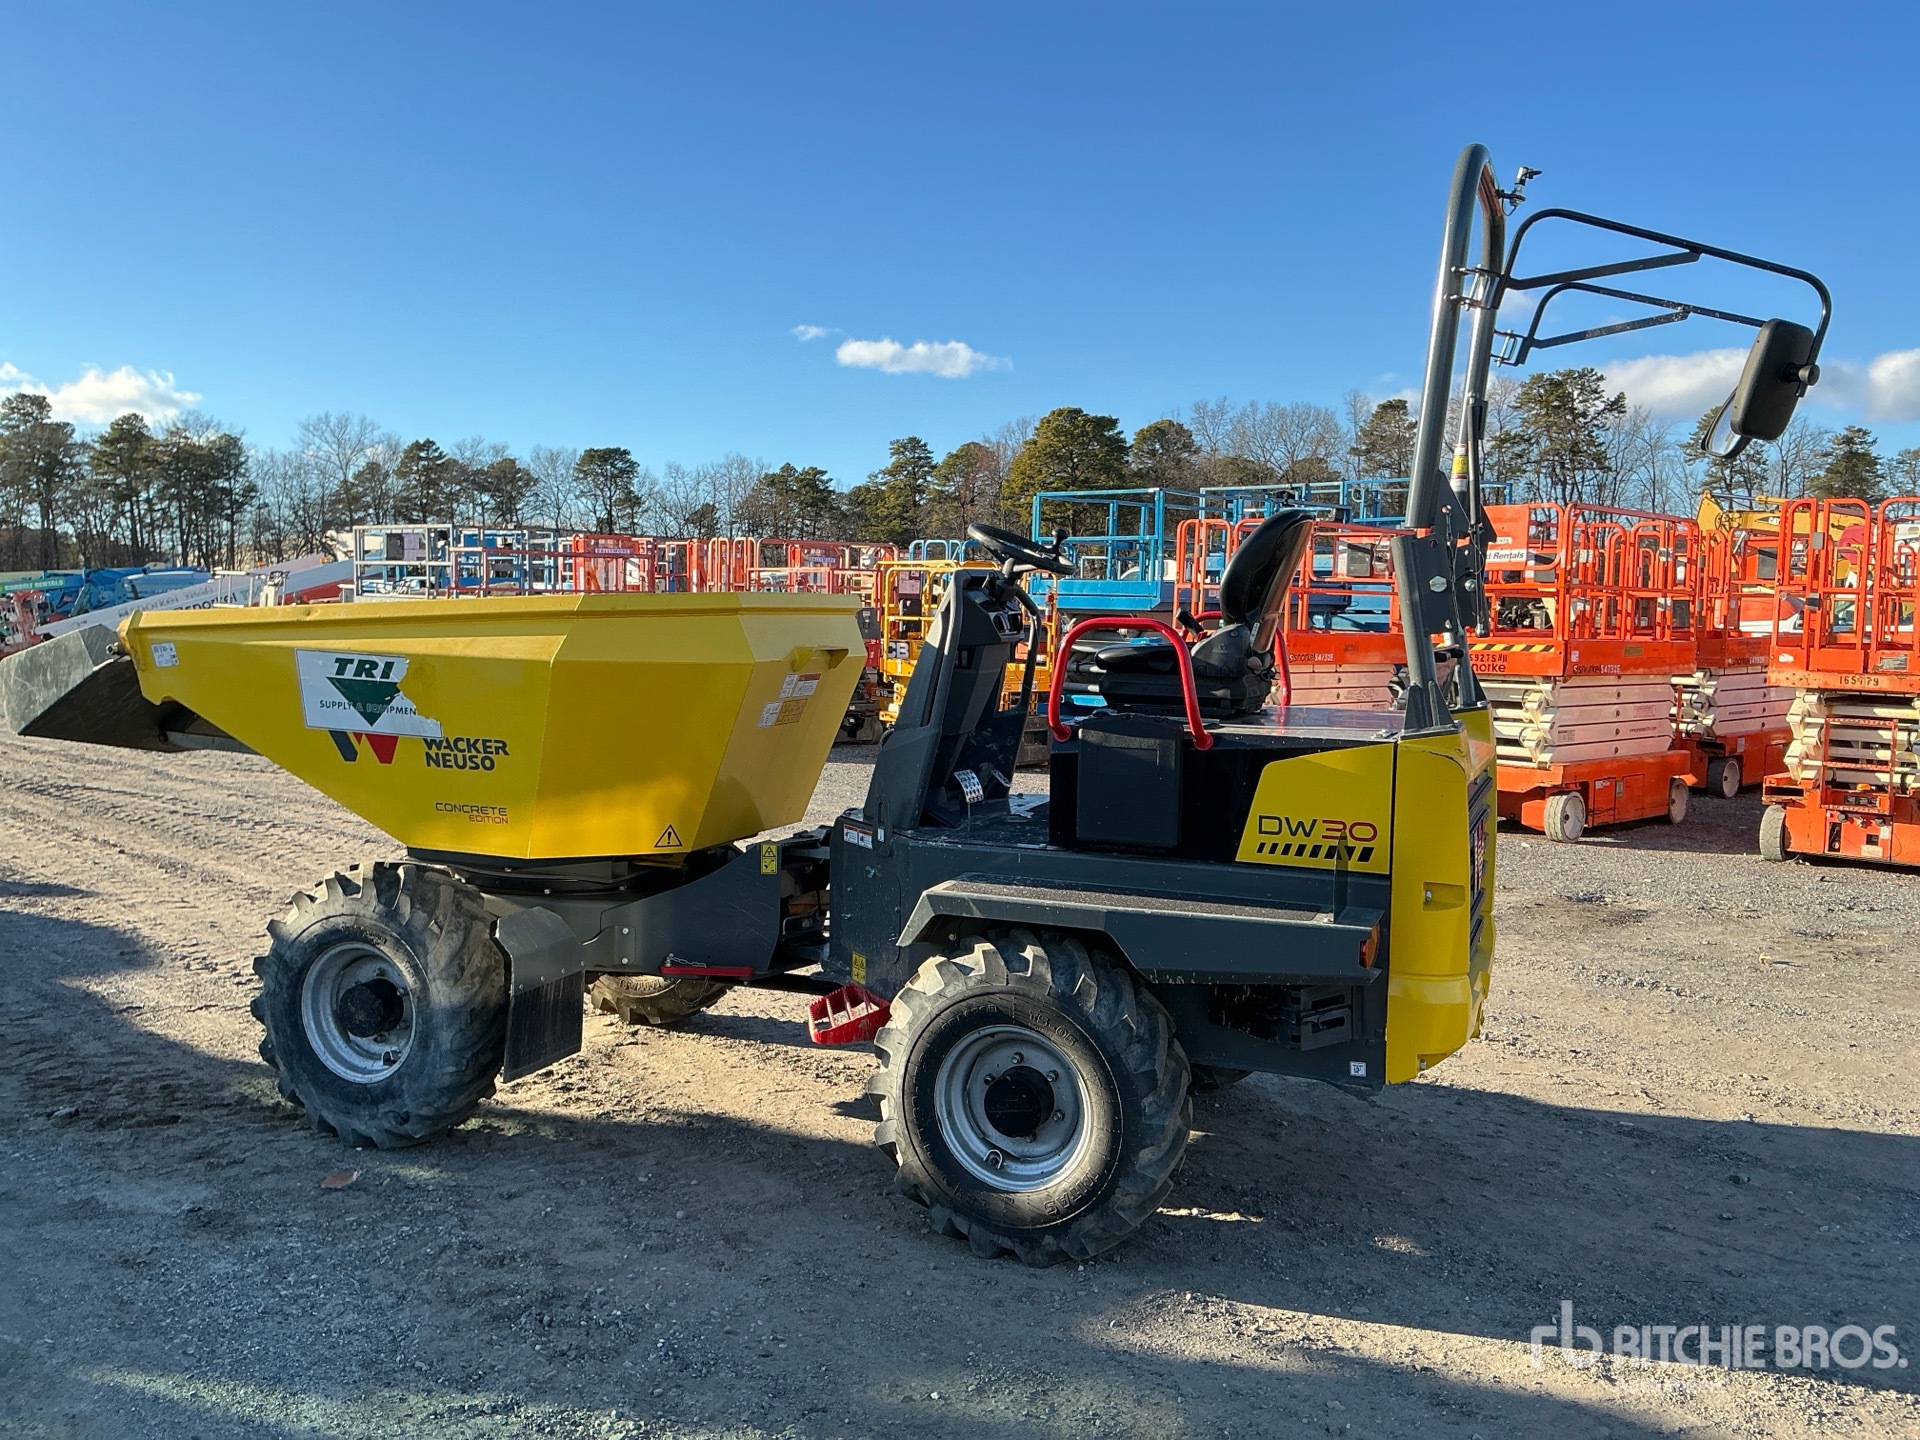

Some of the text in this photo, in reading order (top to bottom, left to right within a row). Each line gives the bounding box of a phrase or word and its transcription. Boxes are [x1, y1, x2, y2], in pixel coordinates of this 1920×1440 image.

[1493, 551, 1524, 560] Rentals
[887, 642, 910, 659] CB
[334, 657, 394, 680] TRI
[1471, 663, 1506, 673] norke
[319, 700, 353, 711] SUPPLY
[355, 702, 364, 712] &
[423, 737, 509, 756] WACKER
[425, 752, 496, 771] NEUSO
[435, 802, 508, 817] CONCRETE
[468, 814, 509, 825] EDITION
[1258, 814, 1378, 843] DW30
